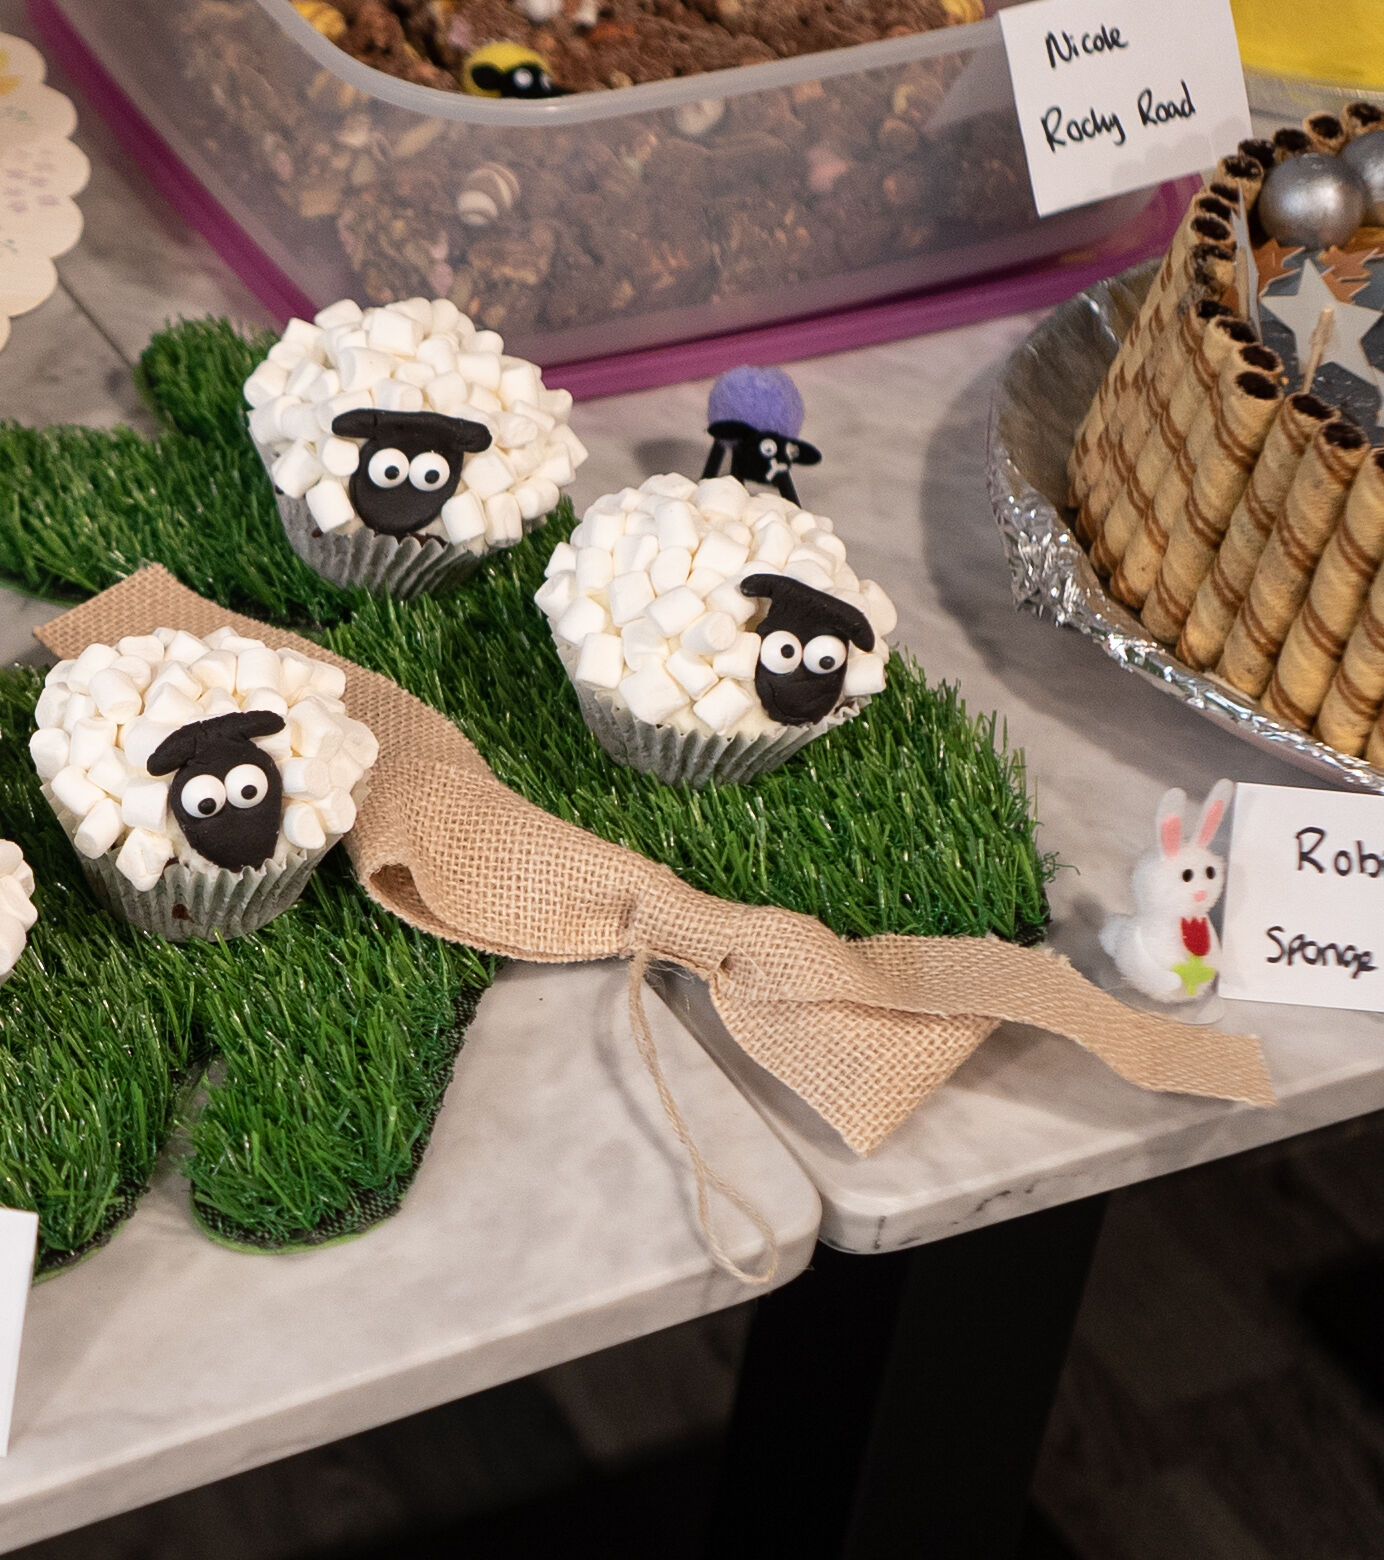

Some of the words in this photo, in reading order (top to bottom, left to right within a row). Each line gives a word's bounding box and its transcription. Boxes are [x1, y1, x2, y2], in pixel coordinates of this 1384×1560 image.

[1045, 24, 1128, 68] Nicole
[1041, 107, 1126, 152] Rocky
[1137, 79, 1196, 126] Road
[1295, 827, 1384, 878] Rob
[1266, 926, 1377, 979] Sponge
